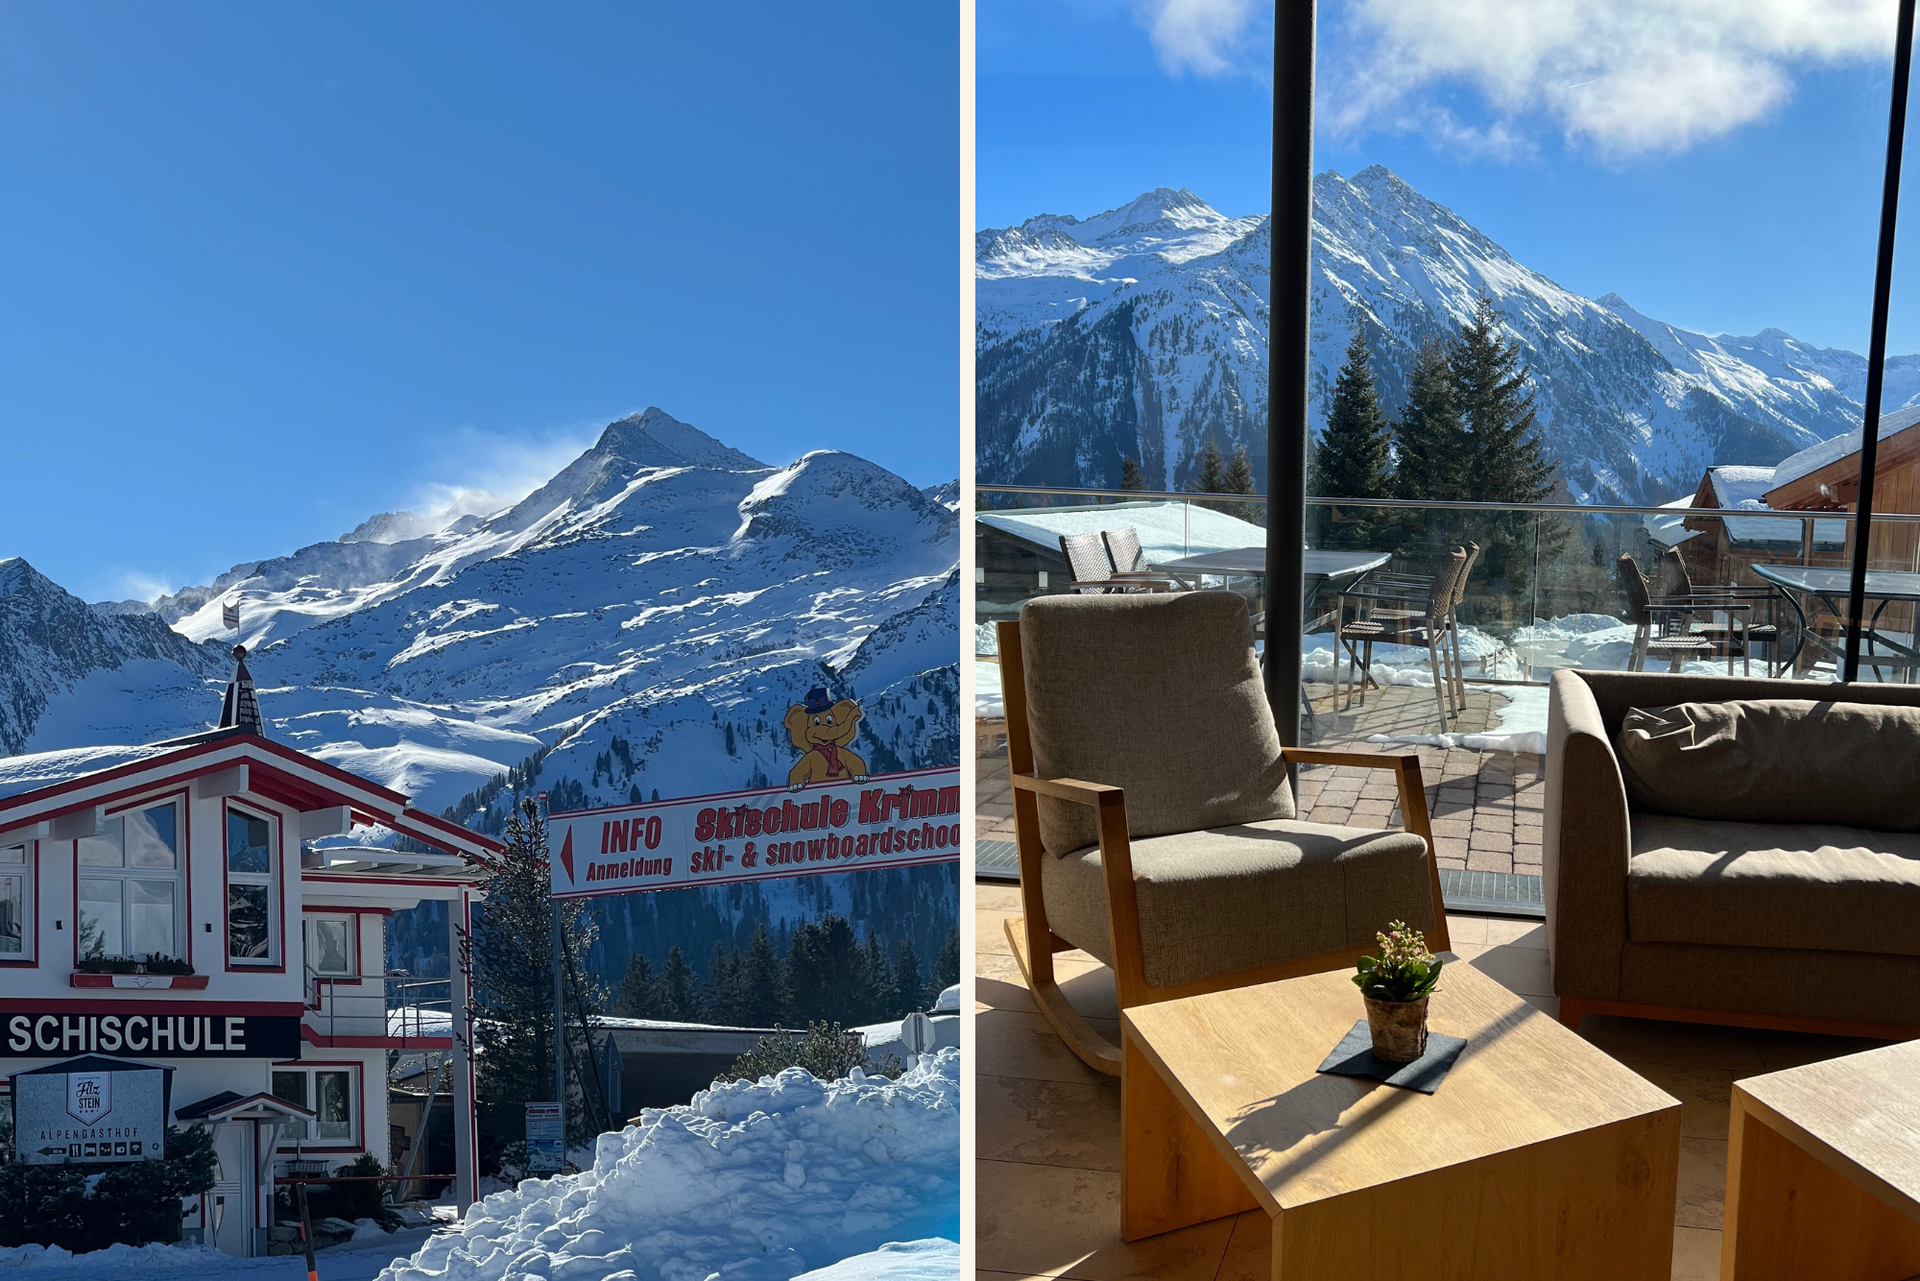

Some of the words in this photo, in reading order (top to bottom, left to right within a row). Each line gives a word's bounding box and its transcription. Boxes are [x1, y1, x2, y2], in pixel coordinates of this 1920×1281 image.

[694, 794, 850, 842] Skischule
[601, 815, 662, 854] INFO
[690, 844, 734, 873] ski-
[741, 841, 759, 868] &
[765, 823, 960, 866] snowboardschoo
[586, 857, 672, 881] Anmeldung
[8, 1015, 247, 1051] SCHISCHULE
[76, 1080, 100, 1098] Filz
[78, 1097, 100, 1109] STEIN
[40, 1127, 138, 1140] ALPENGASTHOF
